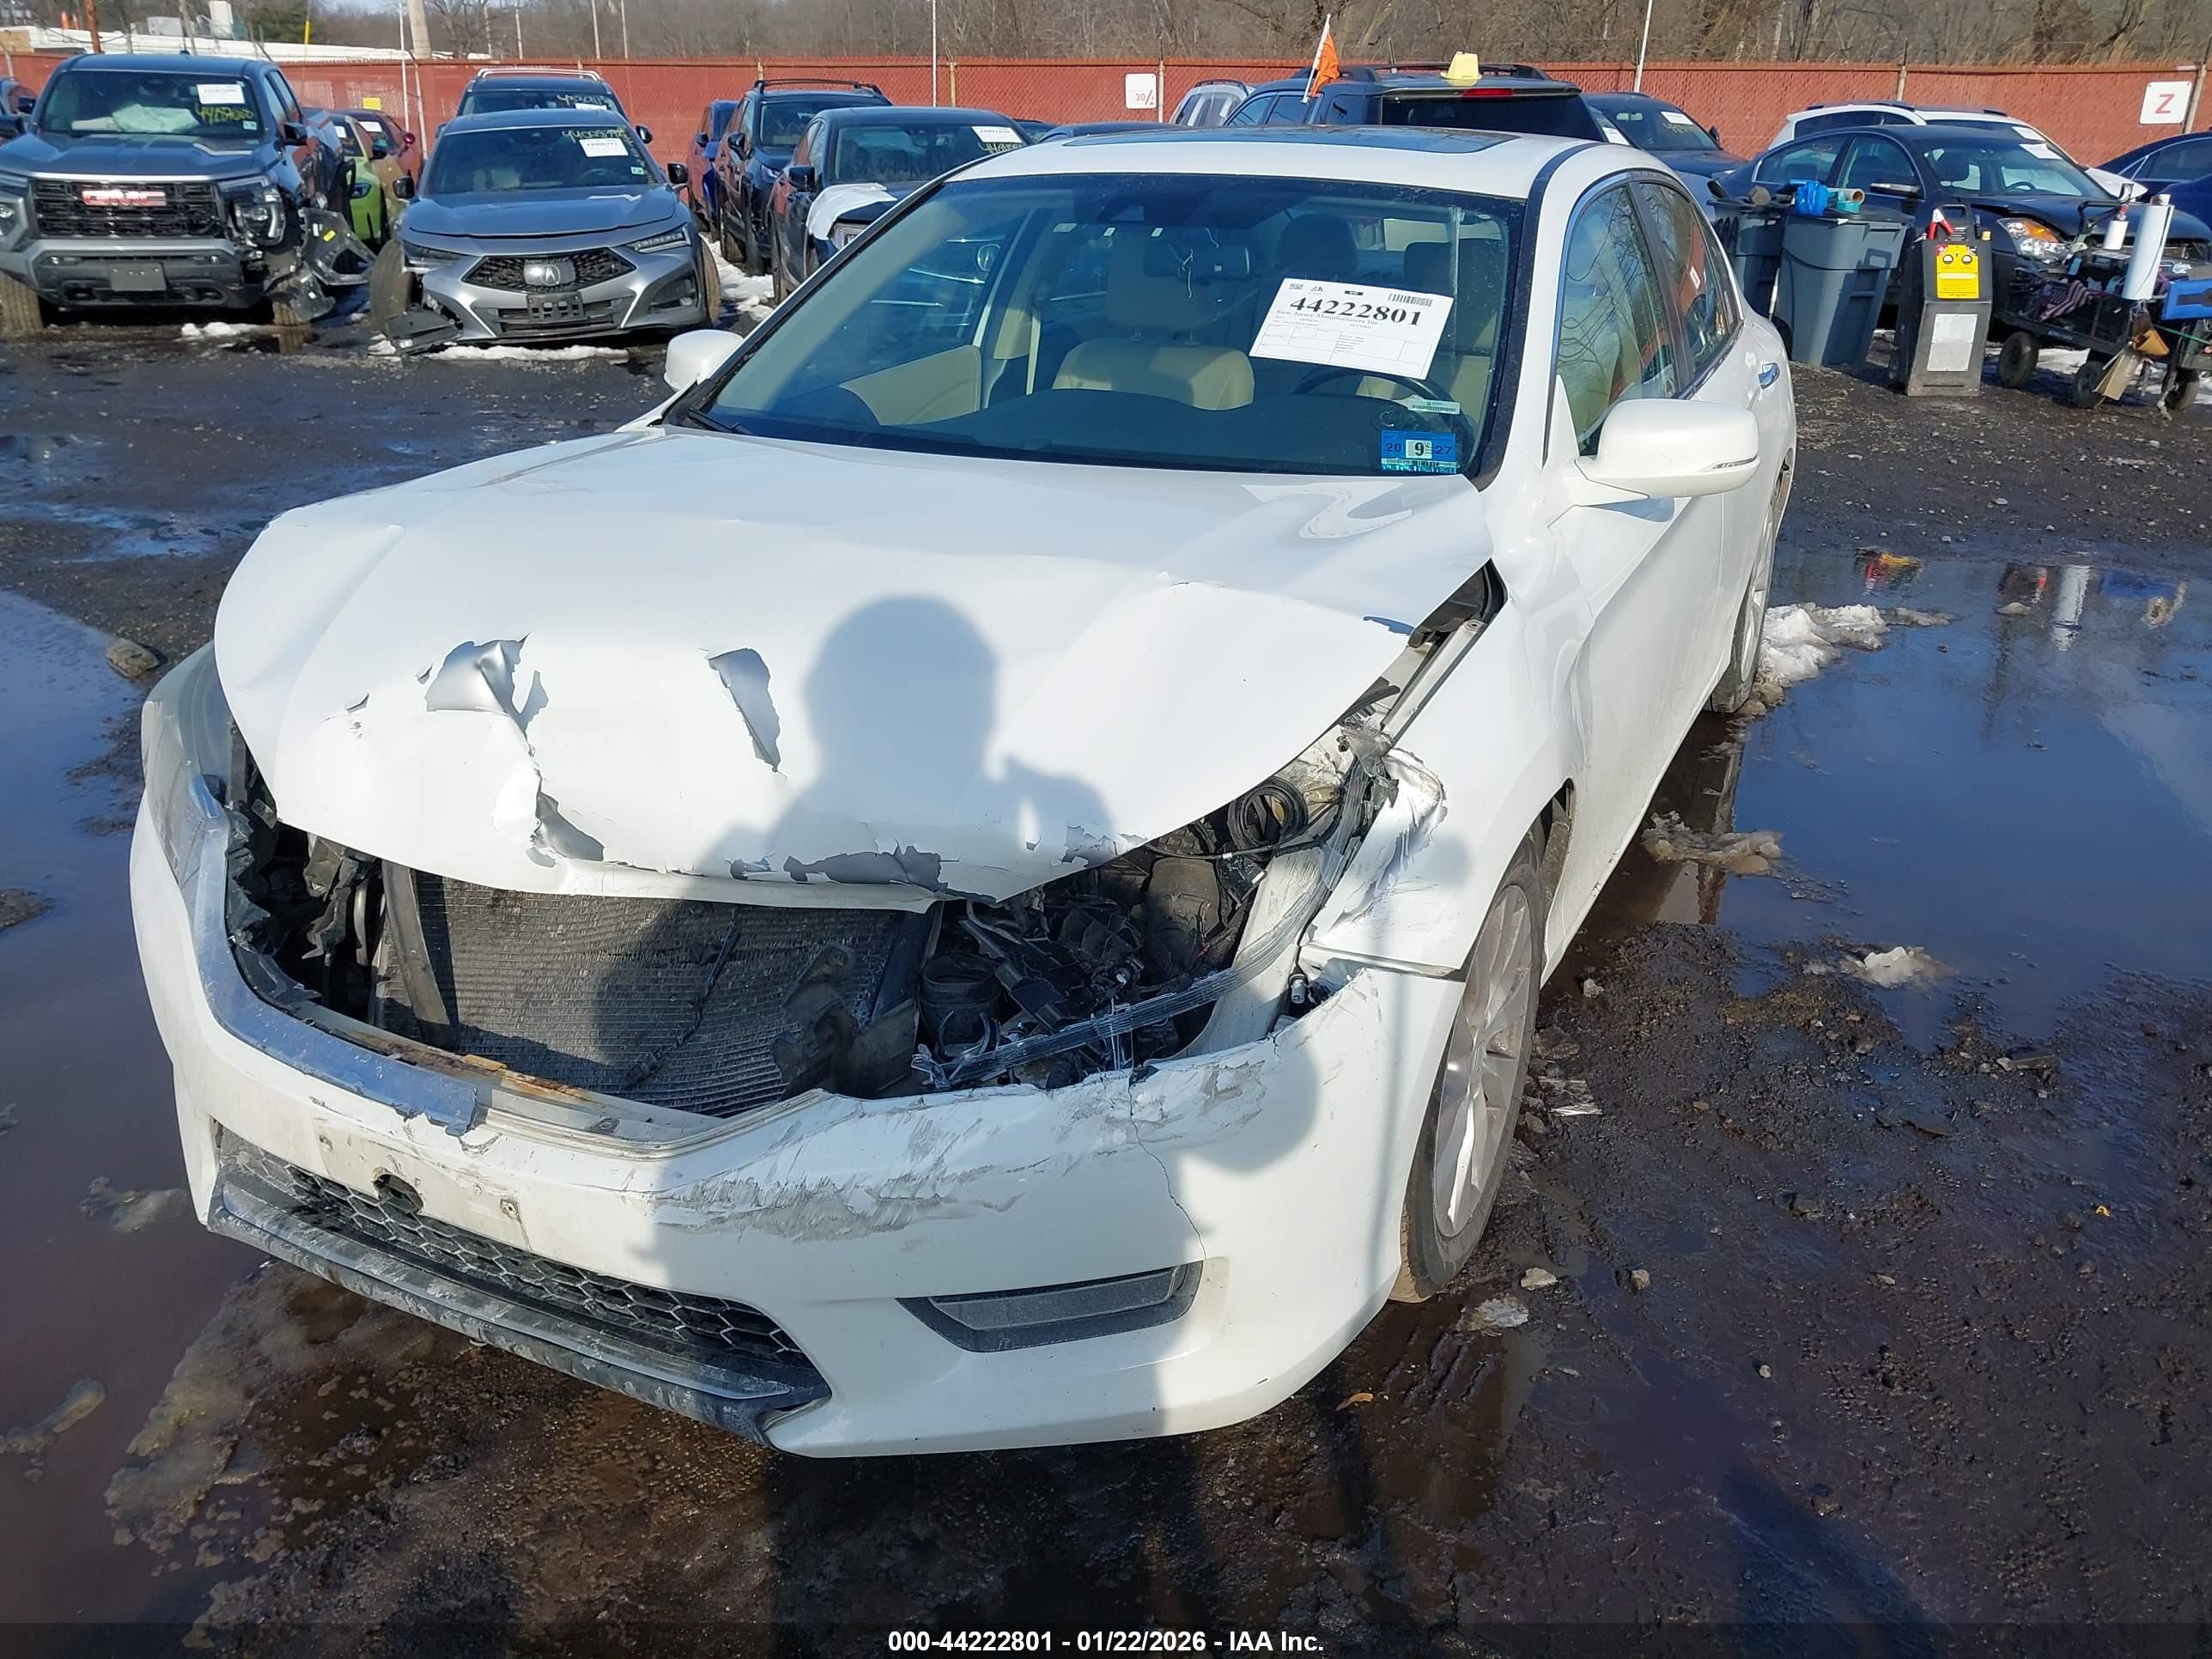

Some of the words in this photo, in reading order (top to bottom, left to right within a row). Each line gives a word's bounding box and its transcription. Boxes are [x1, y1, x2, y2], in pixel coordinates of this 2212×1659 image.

[2154, 94, 2175, 113] Z
[82, 189, 167, 207] GMC
[1290, 297, 1421, 326] 44222801
[1316, 313, 1365, 324] Manufacturers
[1386, 442, 1401, 453] 20
[1414, 441, 1425, 457] 9
[1435, 445, 1453, 455] 27
